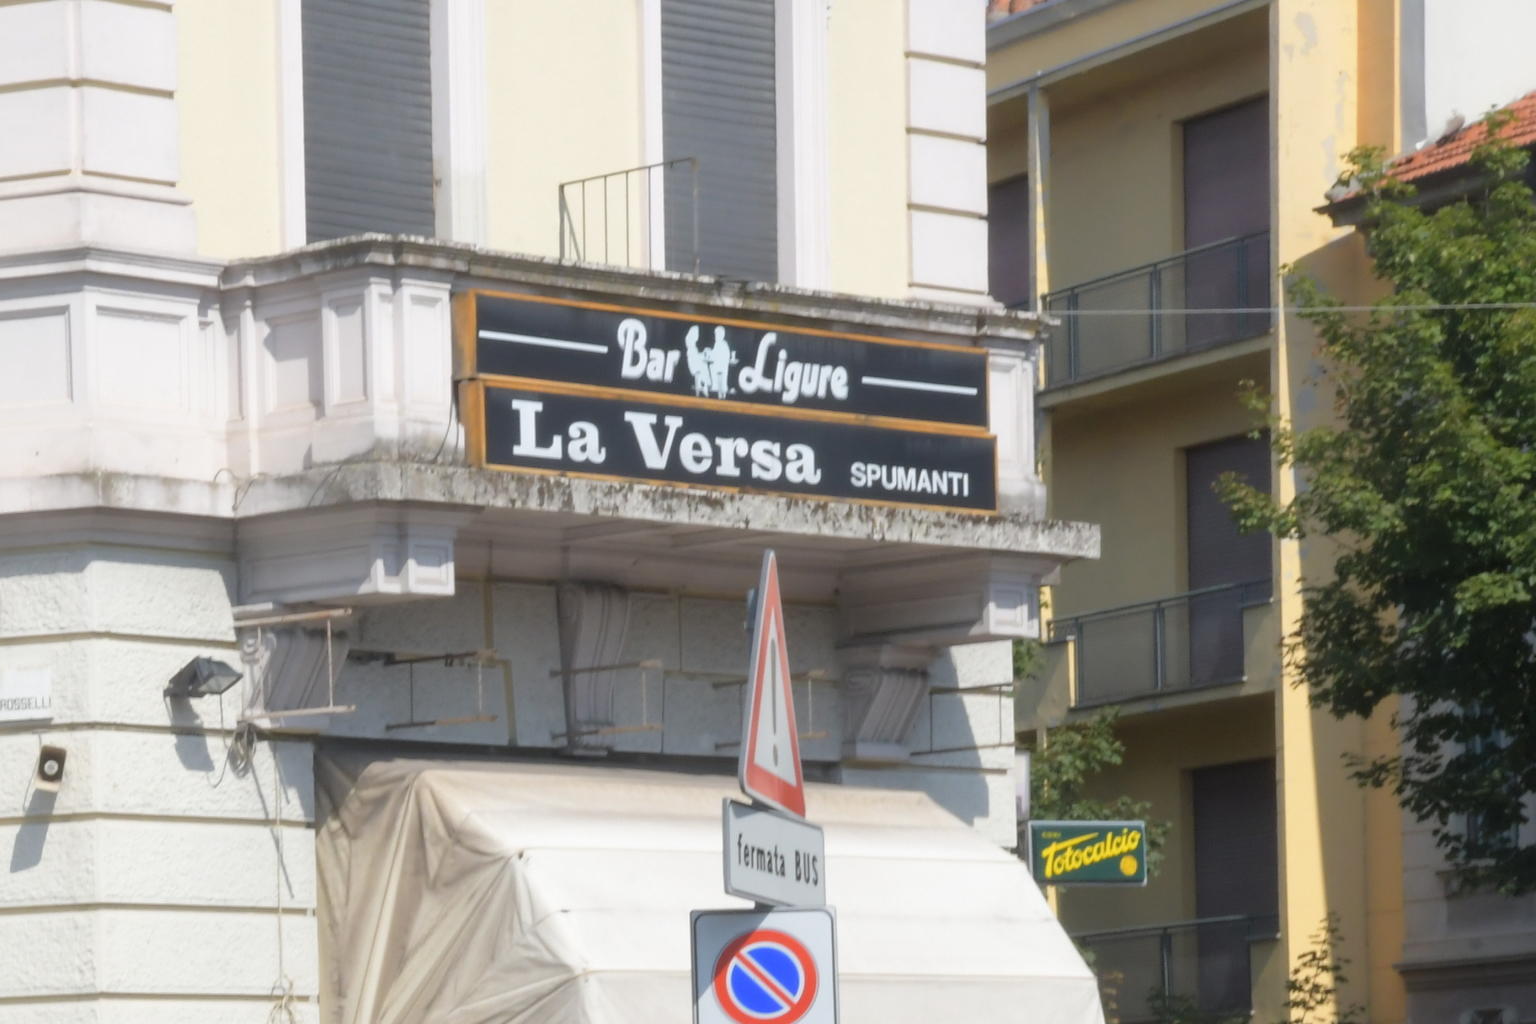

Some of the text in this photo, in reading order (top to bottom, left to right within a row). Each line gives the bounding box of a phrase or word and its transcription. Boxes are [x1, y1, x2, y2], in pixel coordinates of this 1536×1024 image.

[616, 318, 849, 404] Bar Ligure
[511, 400, 822, 484] La Versa
[850, 461, 969, 497] SPUMANTI
[0, 696, 51, 711] ROSSELLI
[737, 833, 818, 887] fermata BUS
[1041, 828, 1141, 878] Totocalcio
